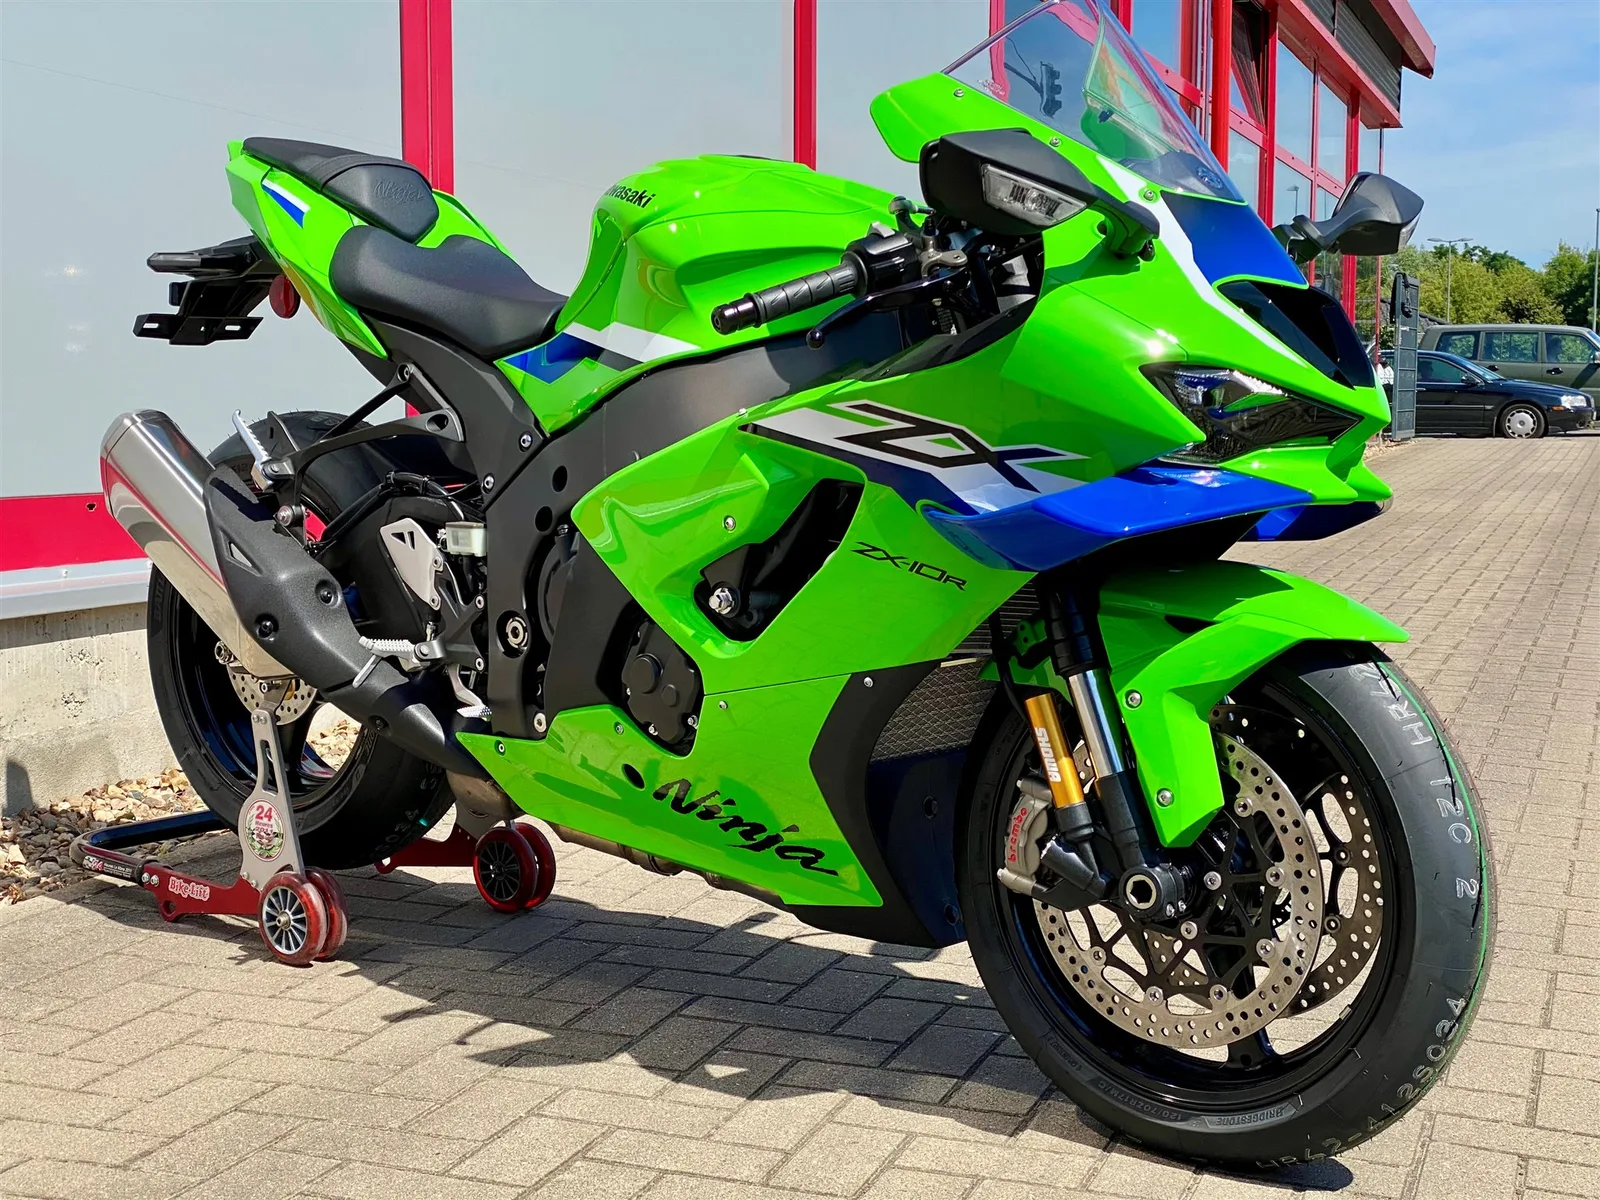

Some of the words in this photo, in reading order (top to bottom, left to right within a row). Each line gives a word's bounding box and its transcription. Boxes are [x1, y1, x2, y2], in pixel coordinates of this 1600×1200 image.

[604, 185, 656, 208] wasaki
[852, 541, 967, 591] ZX-10R
[1034, 726, 1061, 783] SHOWA
[255, 805, 273, 822] 24
[652, 778, 838, 877] Ninja
[1007, 807, 1028, 864] brembo
[1215, 1107, 1286, 1127] BRIDGESTONE
